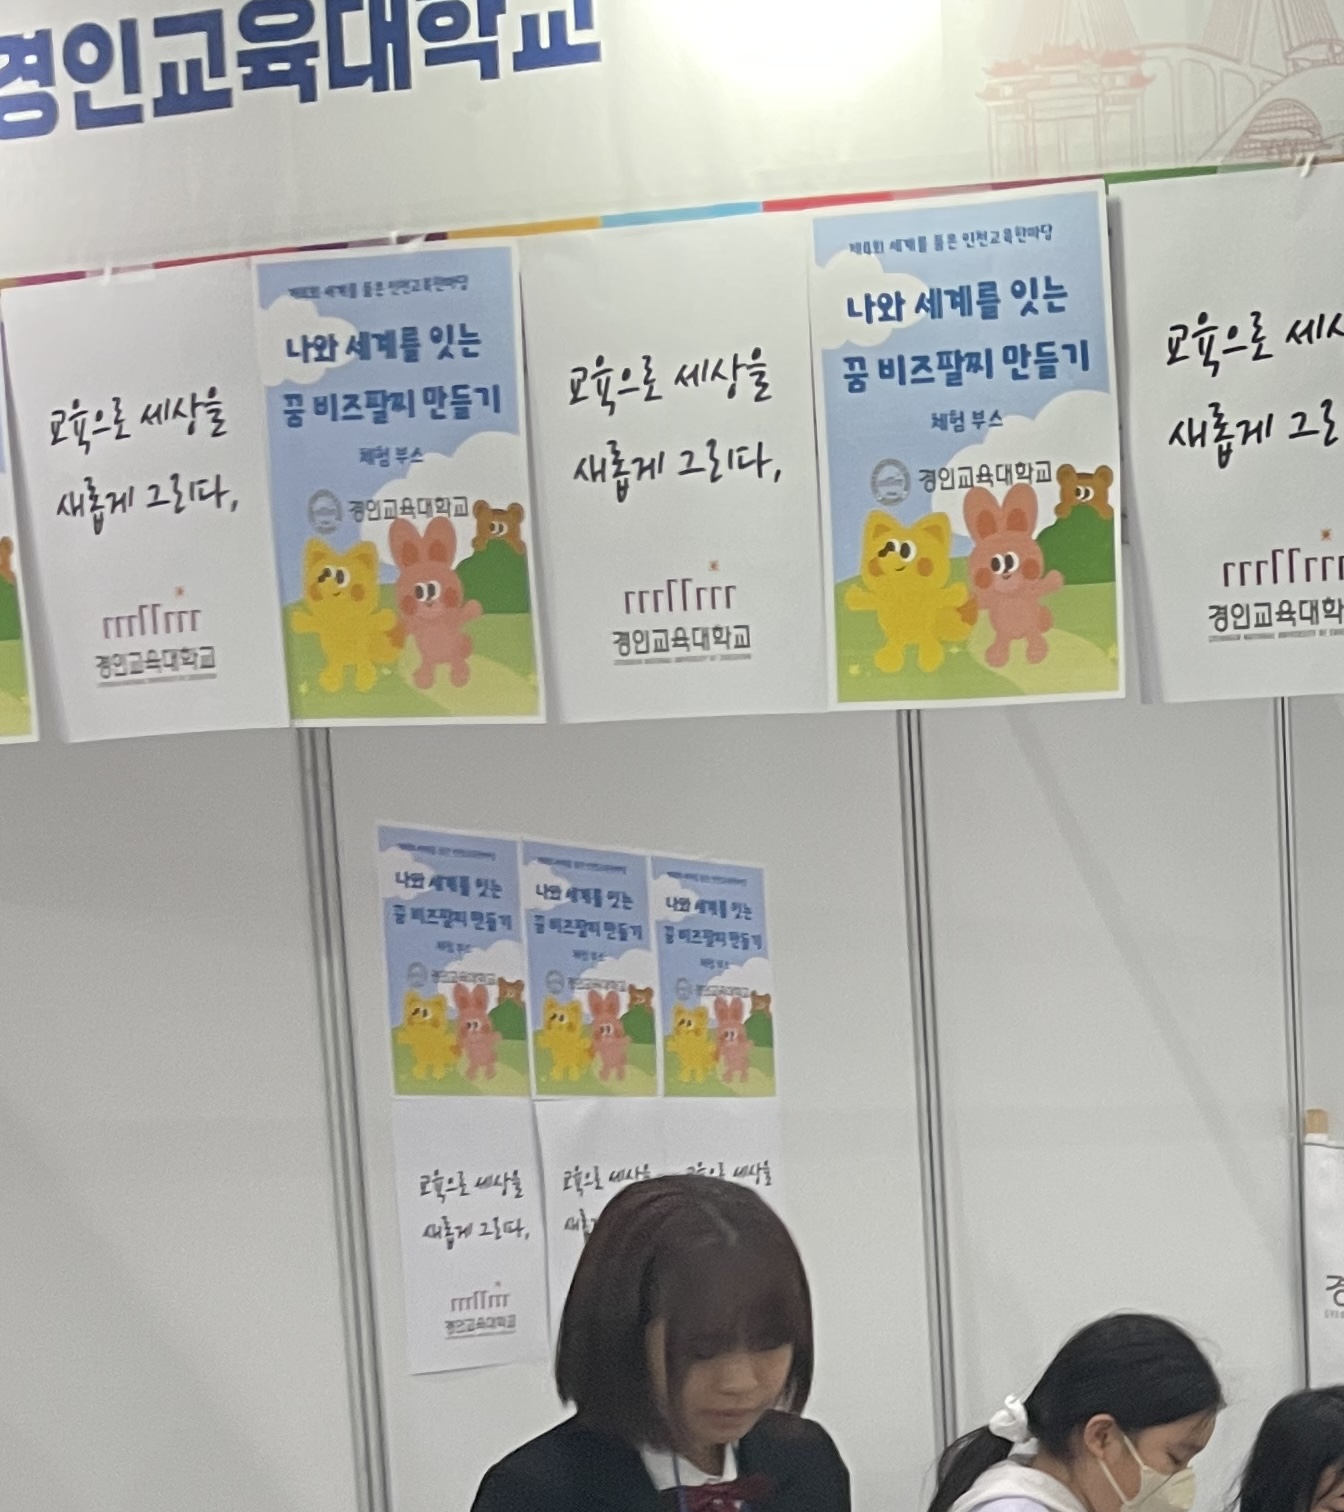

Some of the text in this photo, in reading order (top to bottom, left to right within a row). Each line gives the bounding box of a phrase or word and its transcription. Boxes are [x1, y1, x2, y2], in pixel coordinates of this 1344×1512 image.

[847, 276, 1068, 324] 나와 세계를 잇는
[286, 323, 481, 363] 나와 세계를 잇는
[843, 339, 1089, 393] 꿈 비즈팔찌 만들기
[1167, 311, 1273, 377] 교육으로
[570, 347, 771, 416] 교육으로 세상을
[51, 386, 227, 455] 교육으로 세상을
[283, 384, 500, 428] 꿈 비즈팔찌 만들기
[931, 409, 1003, 433] 체험 부스
[1169, 402, 1273, 469] 새롭게
[574, 438, 781, 503] 새롭게 그리다,
[919, 460, 1052, 493] 경인교육대학교
[57, 473, 238, 535] 새롭게 그리다,
[349, 496, 469, 522] 경인교육대학교
[95, 646, 217, 680] 경인교육대학교
[612, 625, 751, 657] 경인교육대학교
